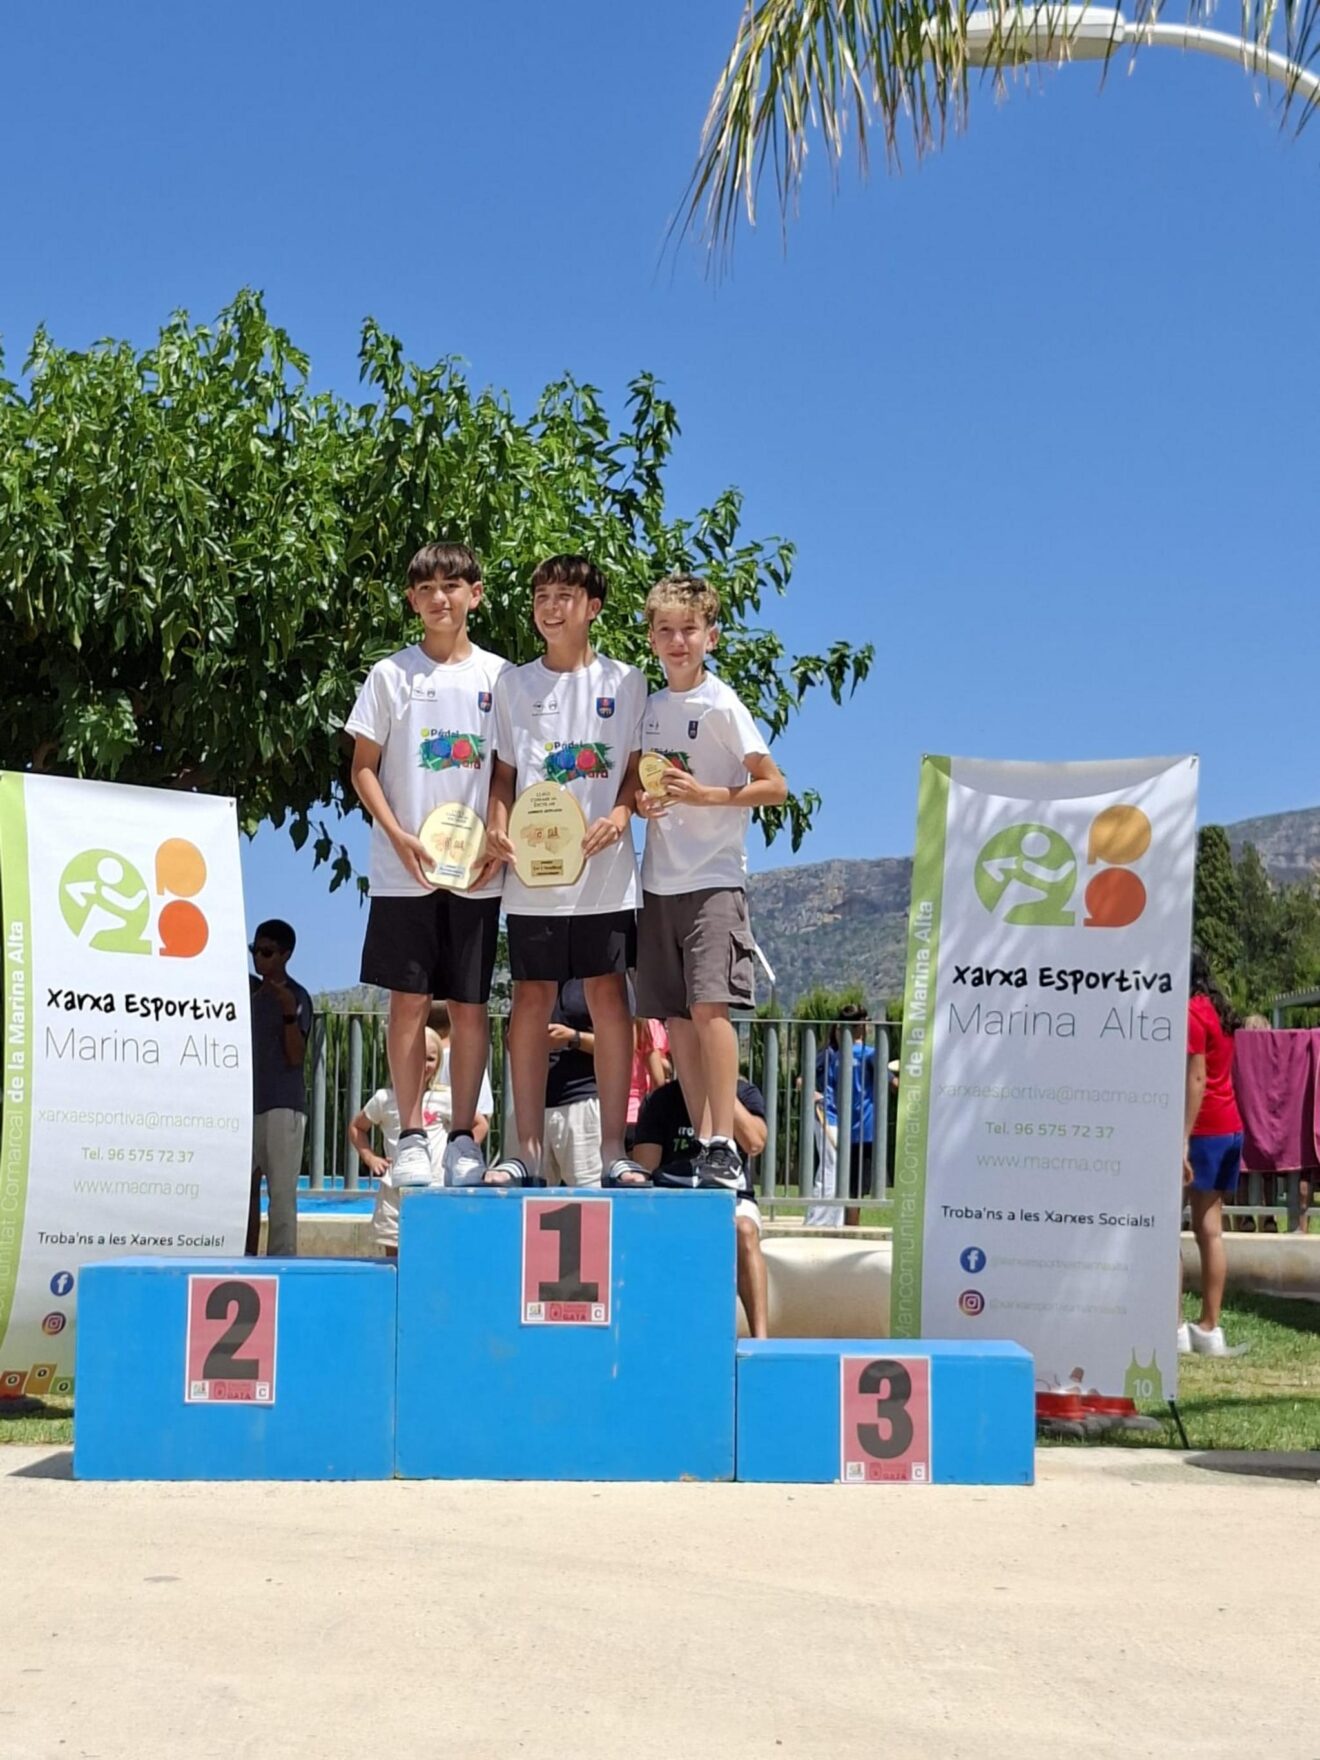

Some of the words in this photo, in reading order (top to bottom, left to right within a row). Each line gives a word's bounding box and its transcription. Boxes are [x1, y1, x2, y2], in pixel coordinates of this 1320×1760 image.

[914, 901, 934, 943] Alta
[8, 921, 25, 964] Alta
[908, 948, 931, 1021] Marina
[1039, 967, 1173, 994] Esportiva
[8, 970, 25, 1044] Marina
[125, 994, 237, 1021] Esportiva
[948, 1002, 1076, 1038] Marina
[1099, 1006, 1172, 1042] Alta
[45, 1026, 160, 1065] Marina
[180, 1034, 239, 1069] Alta
[906, 1028, 926, 1046] la
[8, 1051, 25, 1070] la
[905, 1052, 924, 1078] de
[8, 1076, 24, 1102] de
[938, 1084, 1170, 1108] xarxaesportiva@macma.org
[38, 1109, 240, 1132] xarxaesportiva@macma.org
[985, 1121, 1010, 1135] Tel.
[1014, 1122, 1034, 1136] 96
[1038, 1123, 1067, 1137] 575
[1072, 1124, 1091, 1138] 72
[1095, 1125, 1115, 1139] 37
[899, 1084, 922, 1185] Comarcal
[2, 1110, 23, 1212] Comarcal
[81, 1147, 104, 1161] Tel.
[108, 1148, 125, 1161] 96
[128, 1149, 154, 1163] 575
[158, 1150, 175, 1163] 72
[177, 1150, 195, 1164] 37
[976, 1154, 1121, 1177] www.macma.org
[73, 1179, 200, 1199] www.macma.org
[941, 1205, 1003, 1220] Troba'ns
[1007, 1210, 1016, 1221] a
[1020, 1209, 1040, 1222] les
[1044, 1210, 1094, 1225] Xarxes
[1098, 1212, 1155, 1227] Socials!
[38, 1231, 94, 1245] Troba'ns
[97, 1235, 105, 1245] a
[109, 1233, 126, 1246] les
[130, 1233, 174, 1247] Xarxes
[177, 1234, 225, 1247] Socials!
[539, 1203, 599, 1302] 1
[202, 1281, 261, 1380] 2
[857, 1359, 914, 1459] 3
